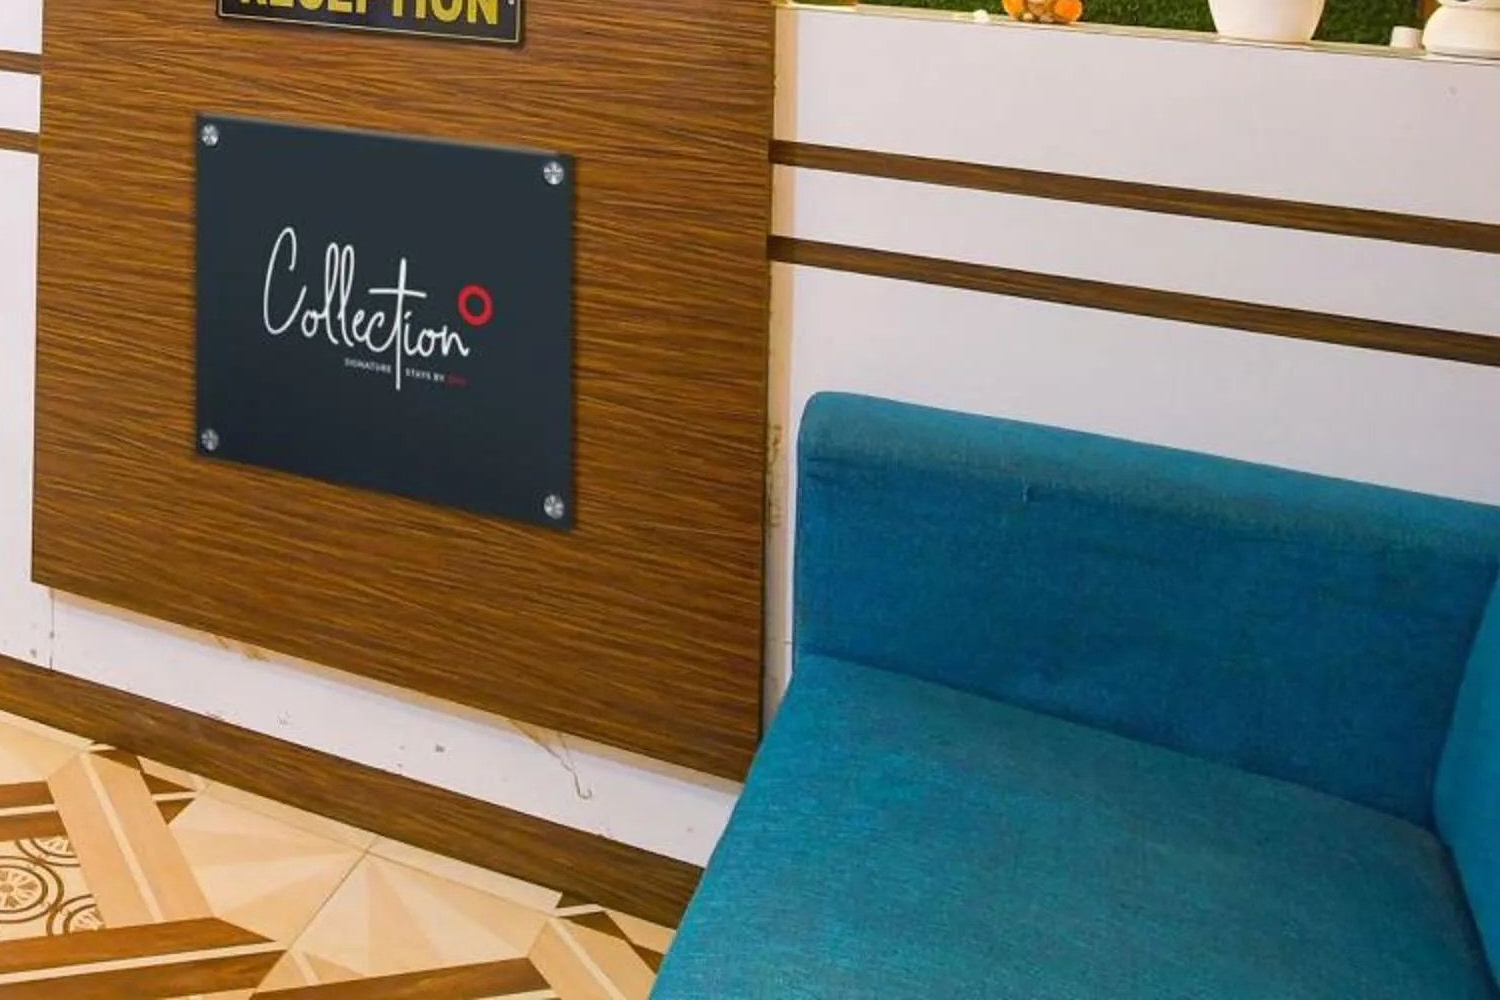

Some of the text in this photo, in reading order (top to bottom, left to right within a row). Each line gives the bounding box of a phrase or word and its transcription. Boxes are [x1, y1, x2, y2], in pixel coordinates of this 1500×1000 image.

[262, 226, 471, 391] Collection
[344, 357, 391, 374] SIGNATURE
[405, 367, 430, 380] STAYS
